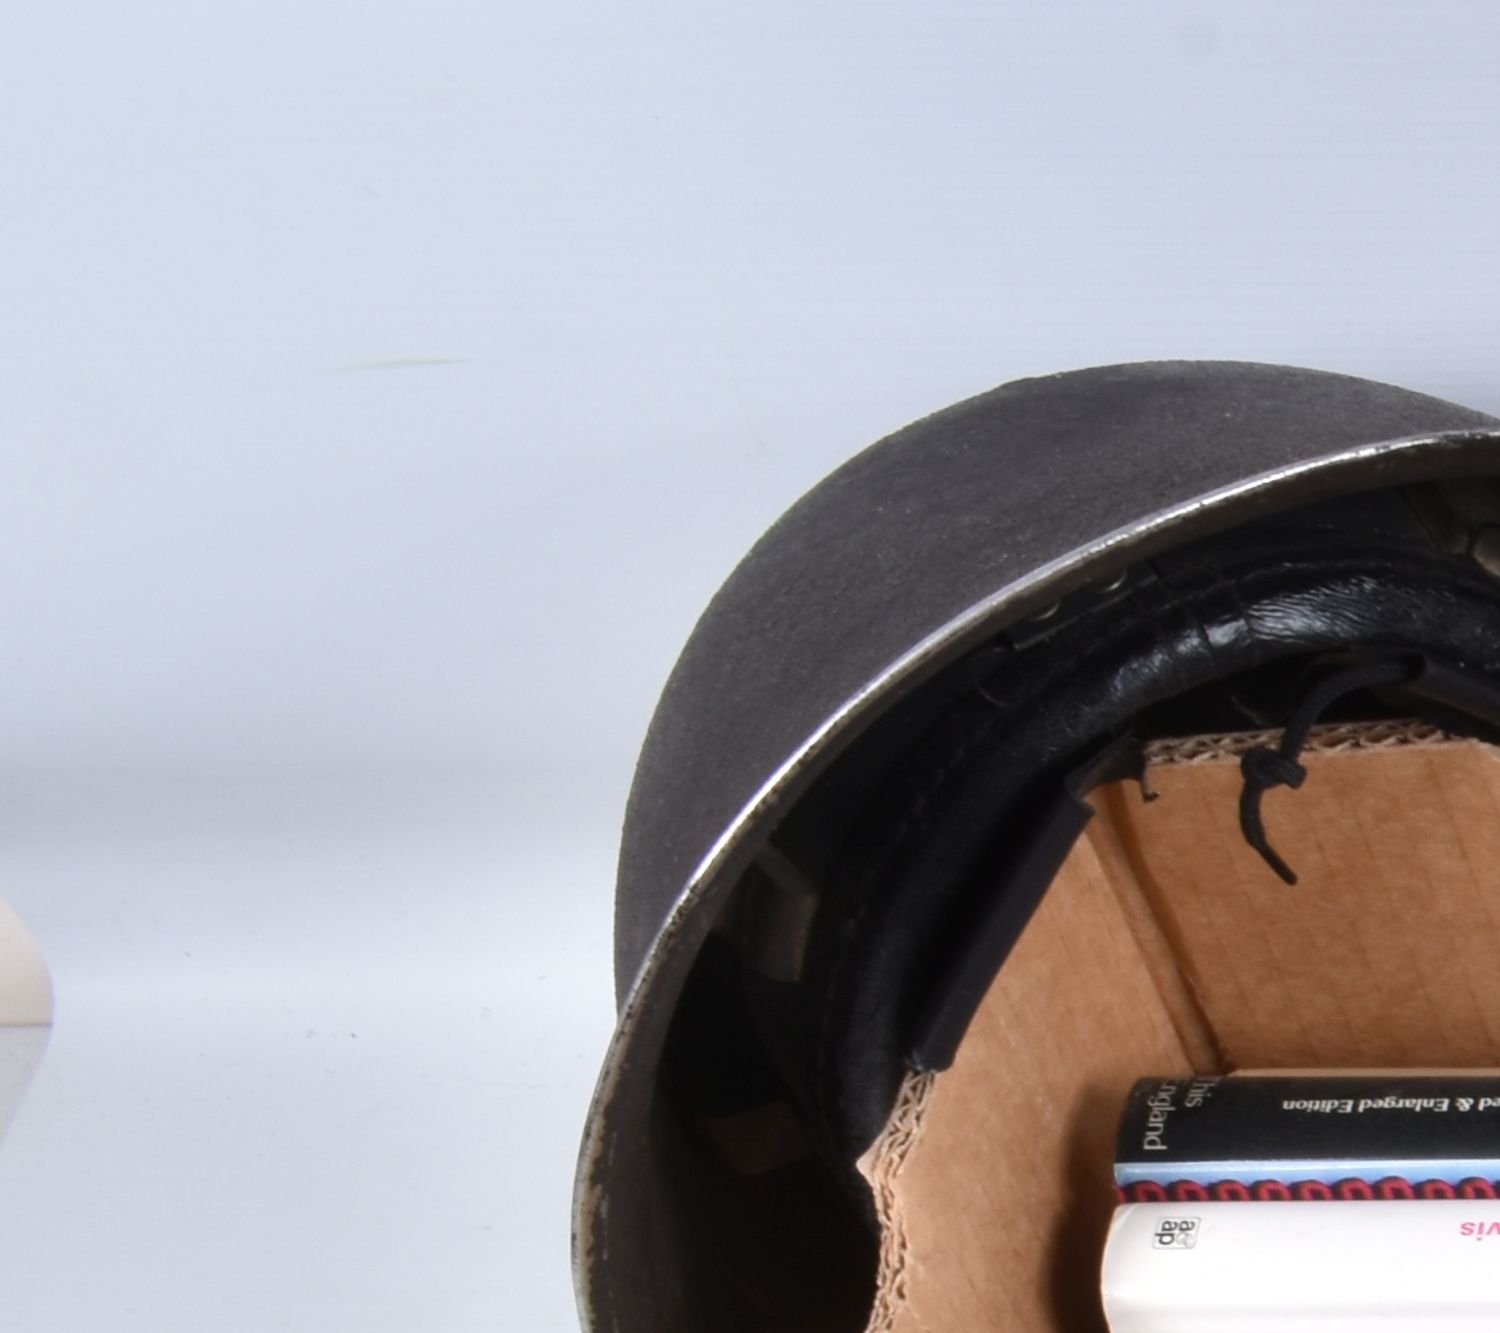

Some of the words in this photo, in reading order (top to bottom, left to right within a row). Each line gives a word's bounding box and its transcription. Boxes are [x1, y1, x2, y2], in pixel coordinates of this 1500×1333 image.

[1281, 1098, 1354, 1114] Edition
[1360, 1096, 1452, 1114] Enlarged
[1456, 1096, 1479, 1112] &
